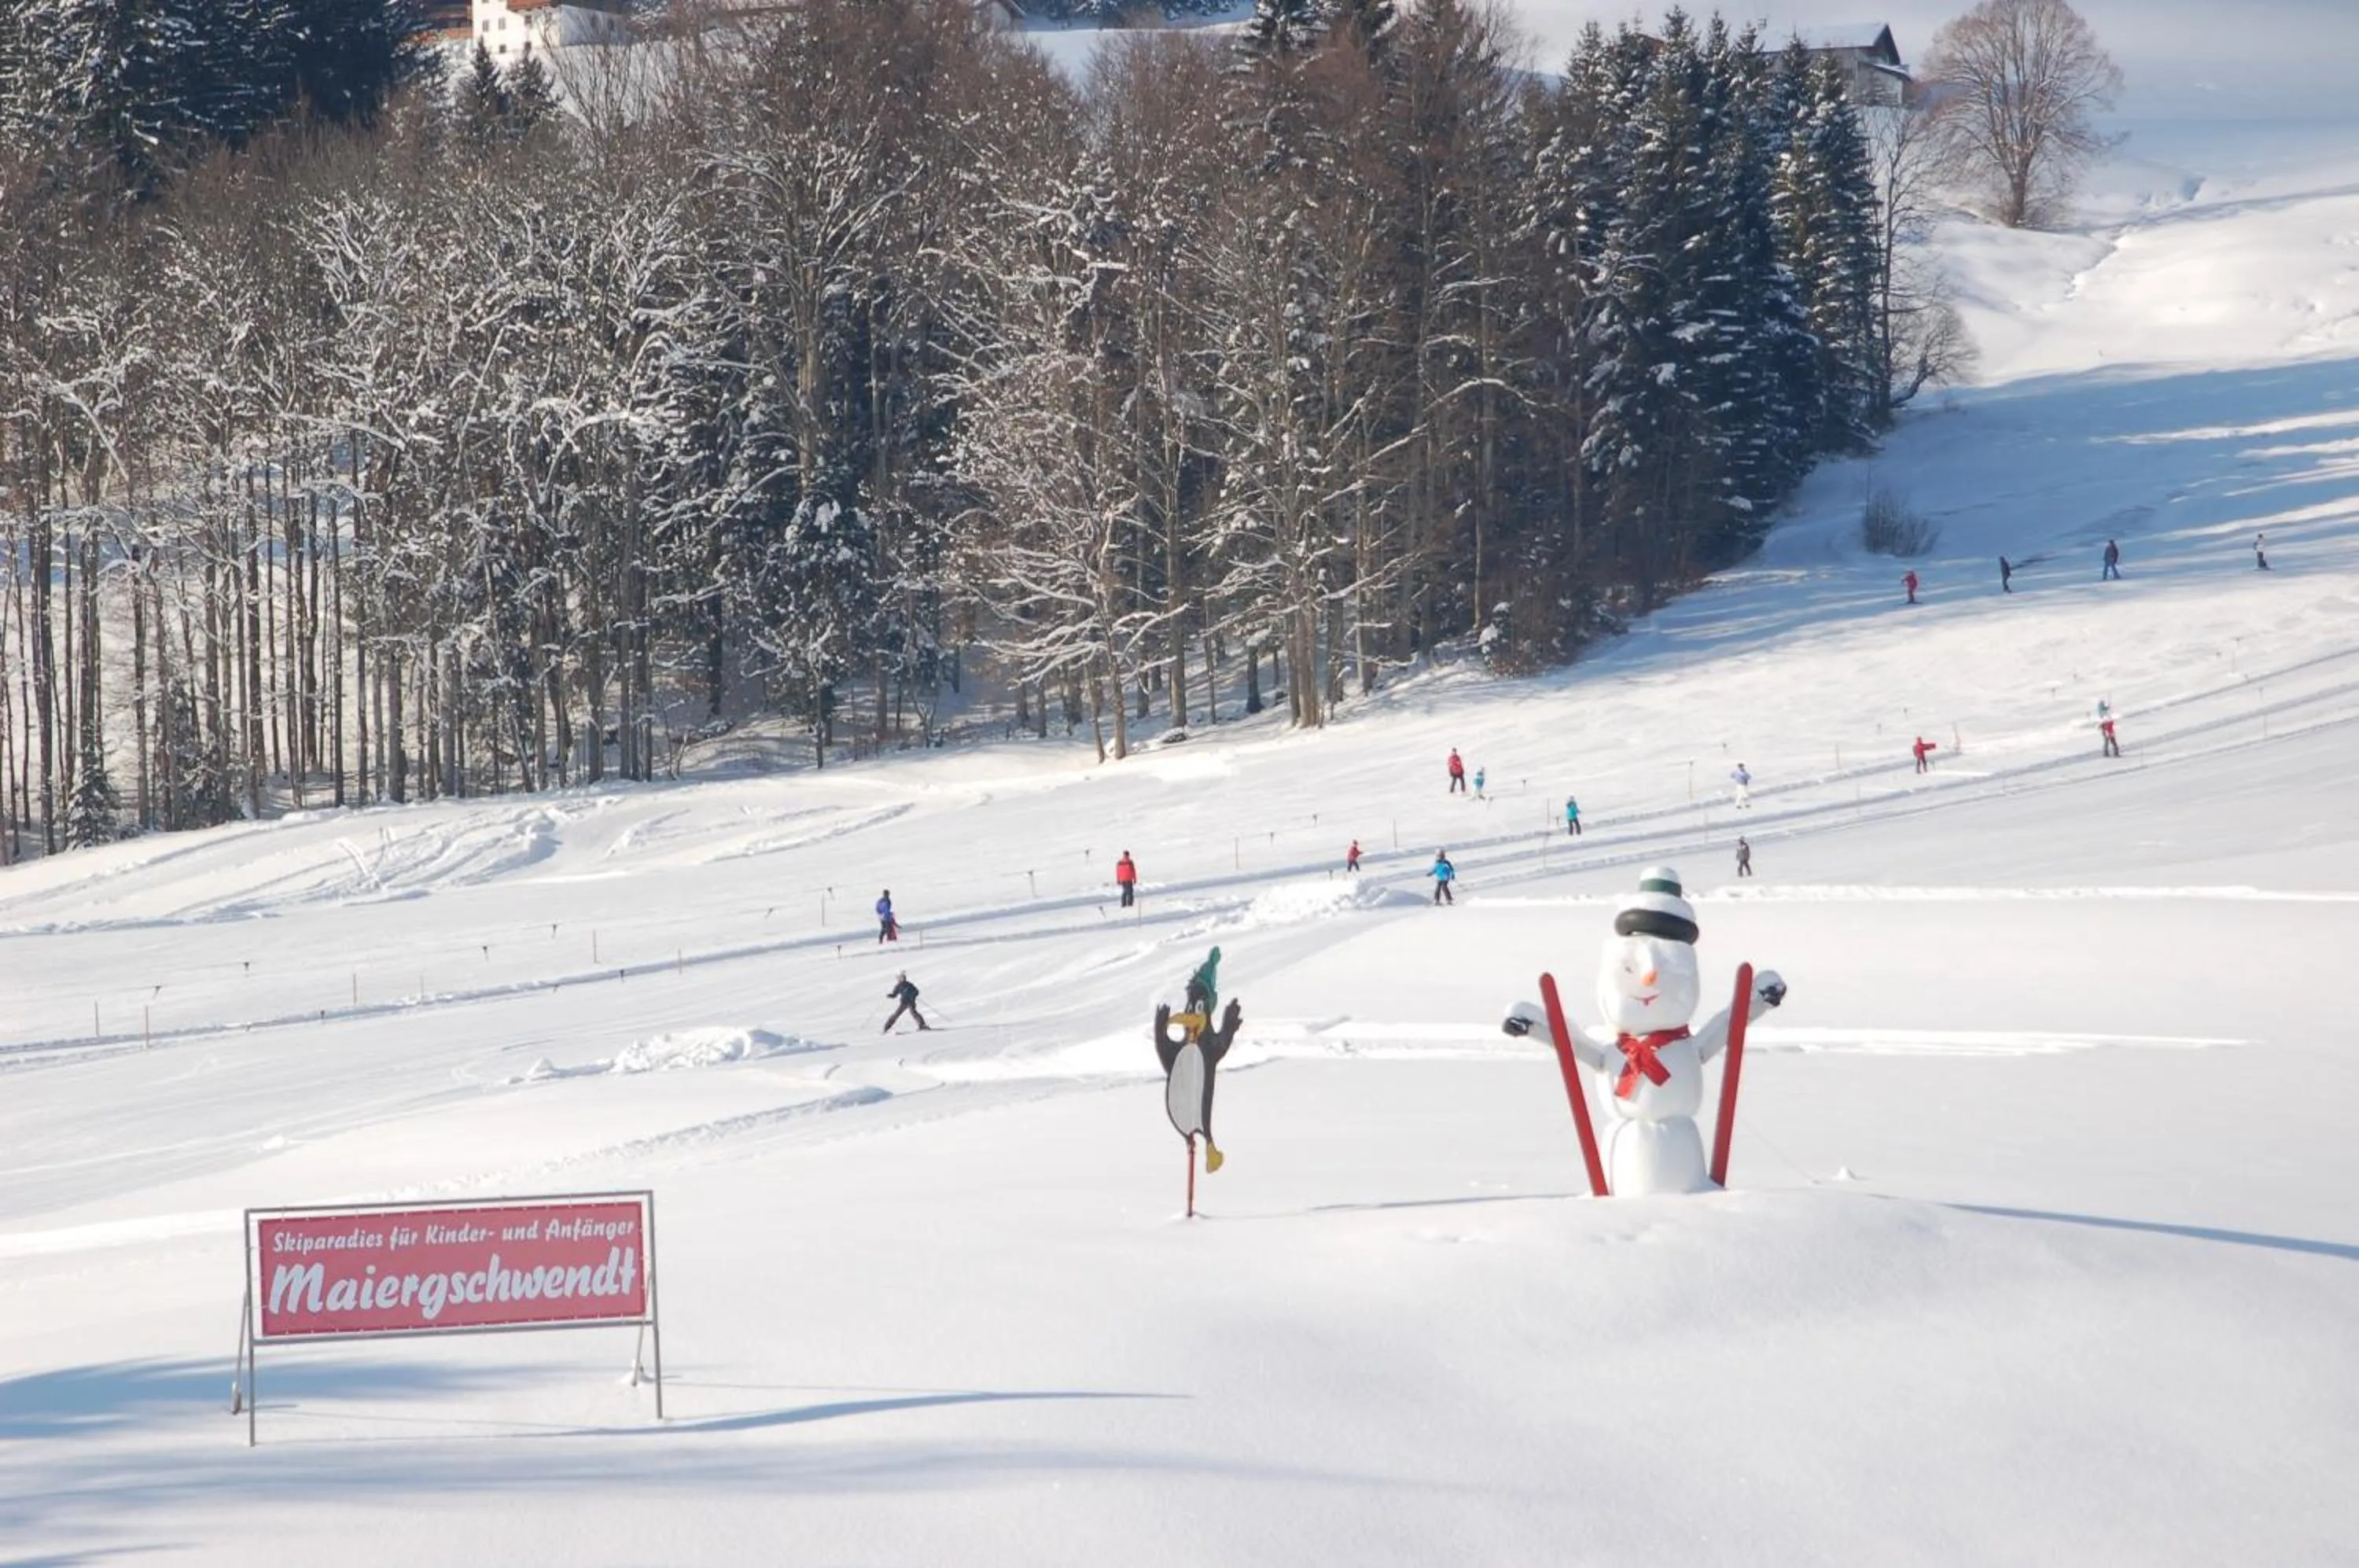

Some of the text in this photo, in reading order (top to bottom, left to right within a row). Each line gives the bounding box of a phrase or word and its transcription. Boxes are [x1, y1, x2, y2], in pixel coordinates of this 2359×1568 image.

[272, 1218, 635, 1255] Skiparadies für Kinder- und Anfänger
[269, 1246, 636, 1320] Maiergschwendt
